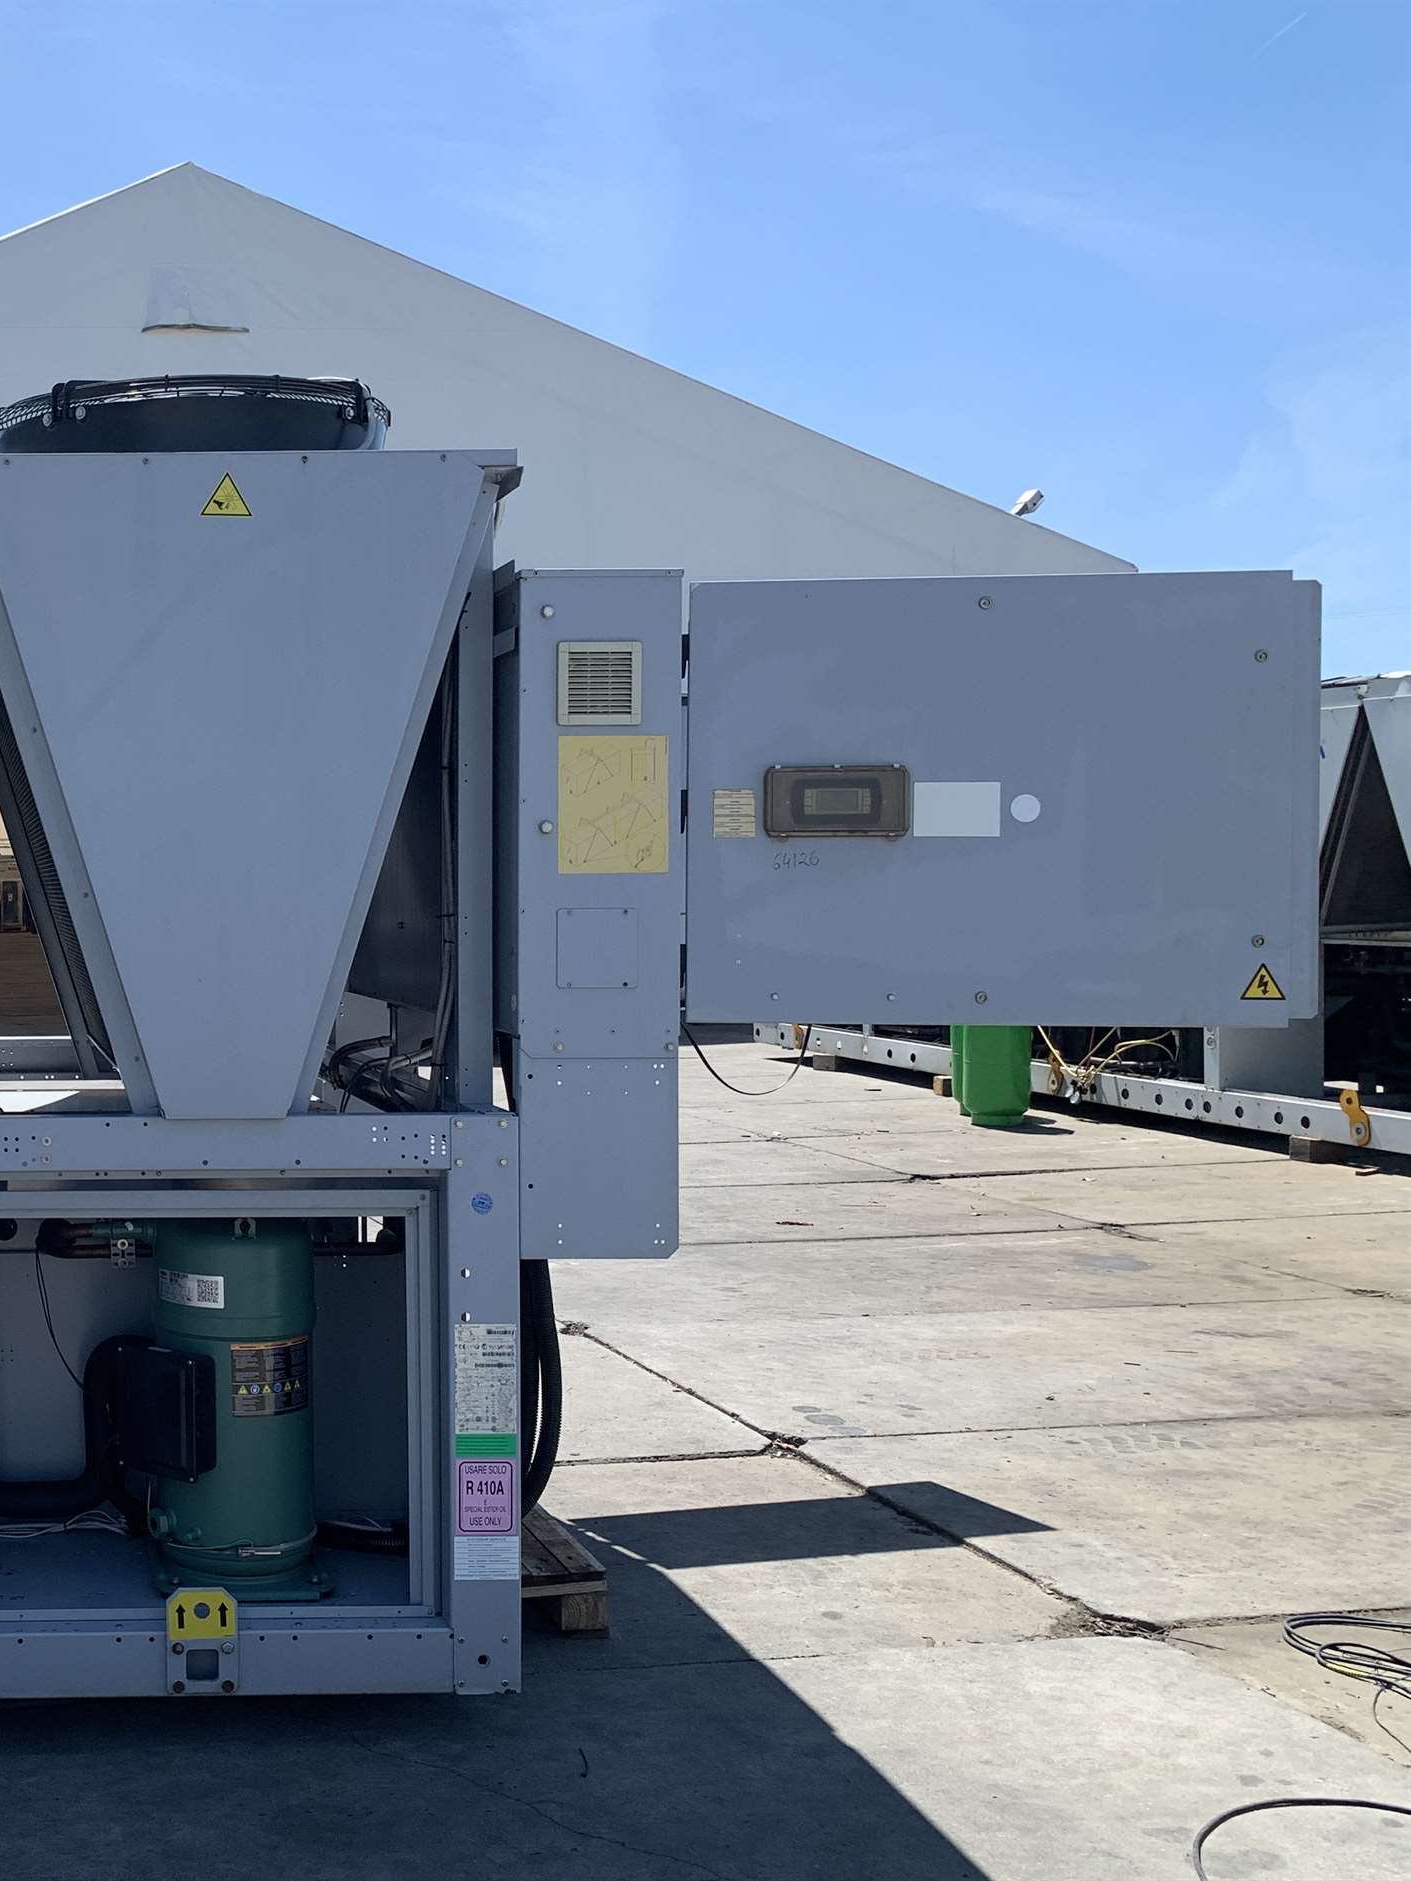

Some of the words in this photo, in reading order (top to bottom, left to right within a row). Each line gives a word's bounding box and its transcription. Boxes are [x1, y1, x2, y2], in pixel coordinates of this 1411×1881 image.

[465, 1465, 487, 1474] USARE
[488, 1465, 507, 1474] SOLO
[466, 1480, 474, 1495] R
[477, 1480, 504, 1495] 410A
[470, 1517, 483, 1526] USE
[484, 1517, 502, 1526] ONLY
